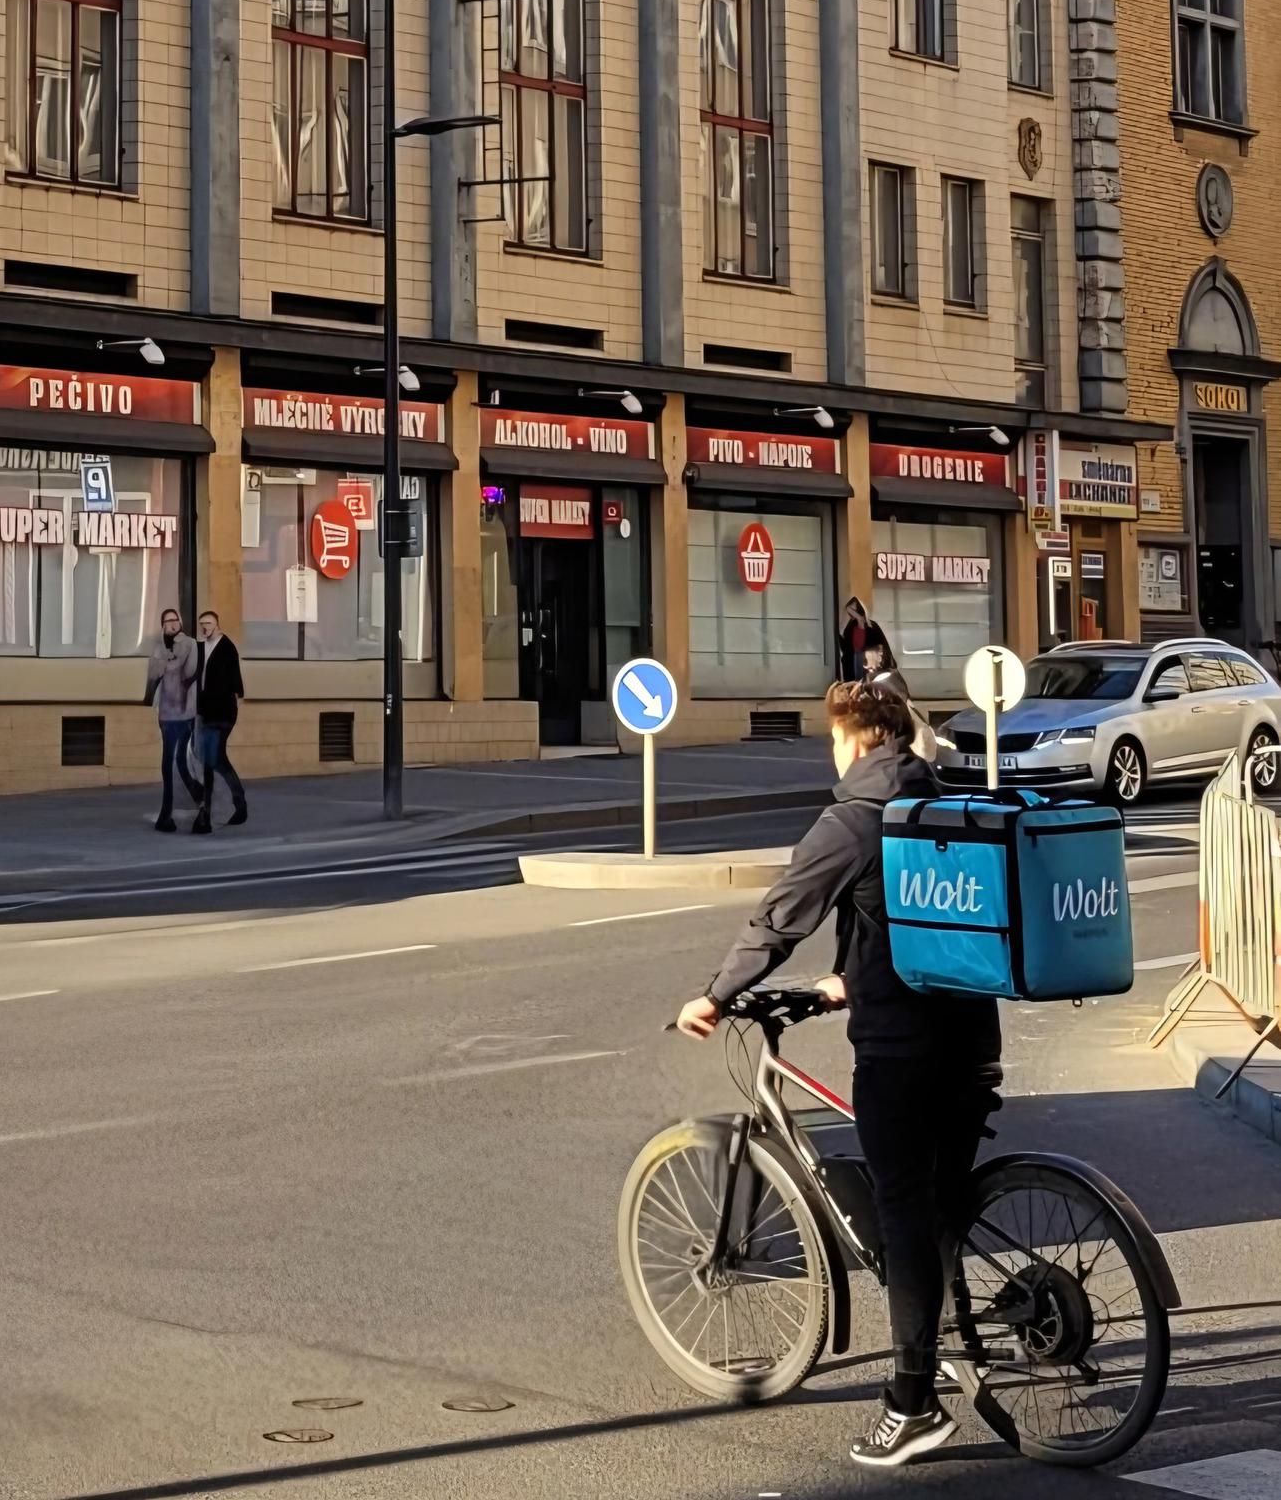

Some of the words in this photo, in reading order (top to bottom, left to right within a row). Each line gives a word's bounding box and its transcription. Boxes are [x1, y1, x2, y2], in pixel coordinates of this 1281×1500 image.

[29, 373, 132, 415] PEČIVO
[340, 401, 427, 438] VÝROKY
[494, 418, 572, 450] ALKOHOL
[589, 421, 628, 454] VÍNO
[708, 437, 744, 464] PIVO
[897, 453, 984, 483] DROGERIE
[78, 510, 178, 549] MARKET
[876, 552, 926, 582] SUPER
[932, 555, 991, 583] MARKET
[899, 867, 984, 913] Wolt
[1052, 876, 1119, 922] Wolt
